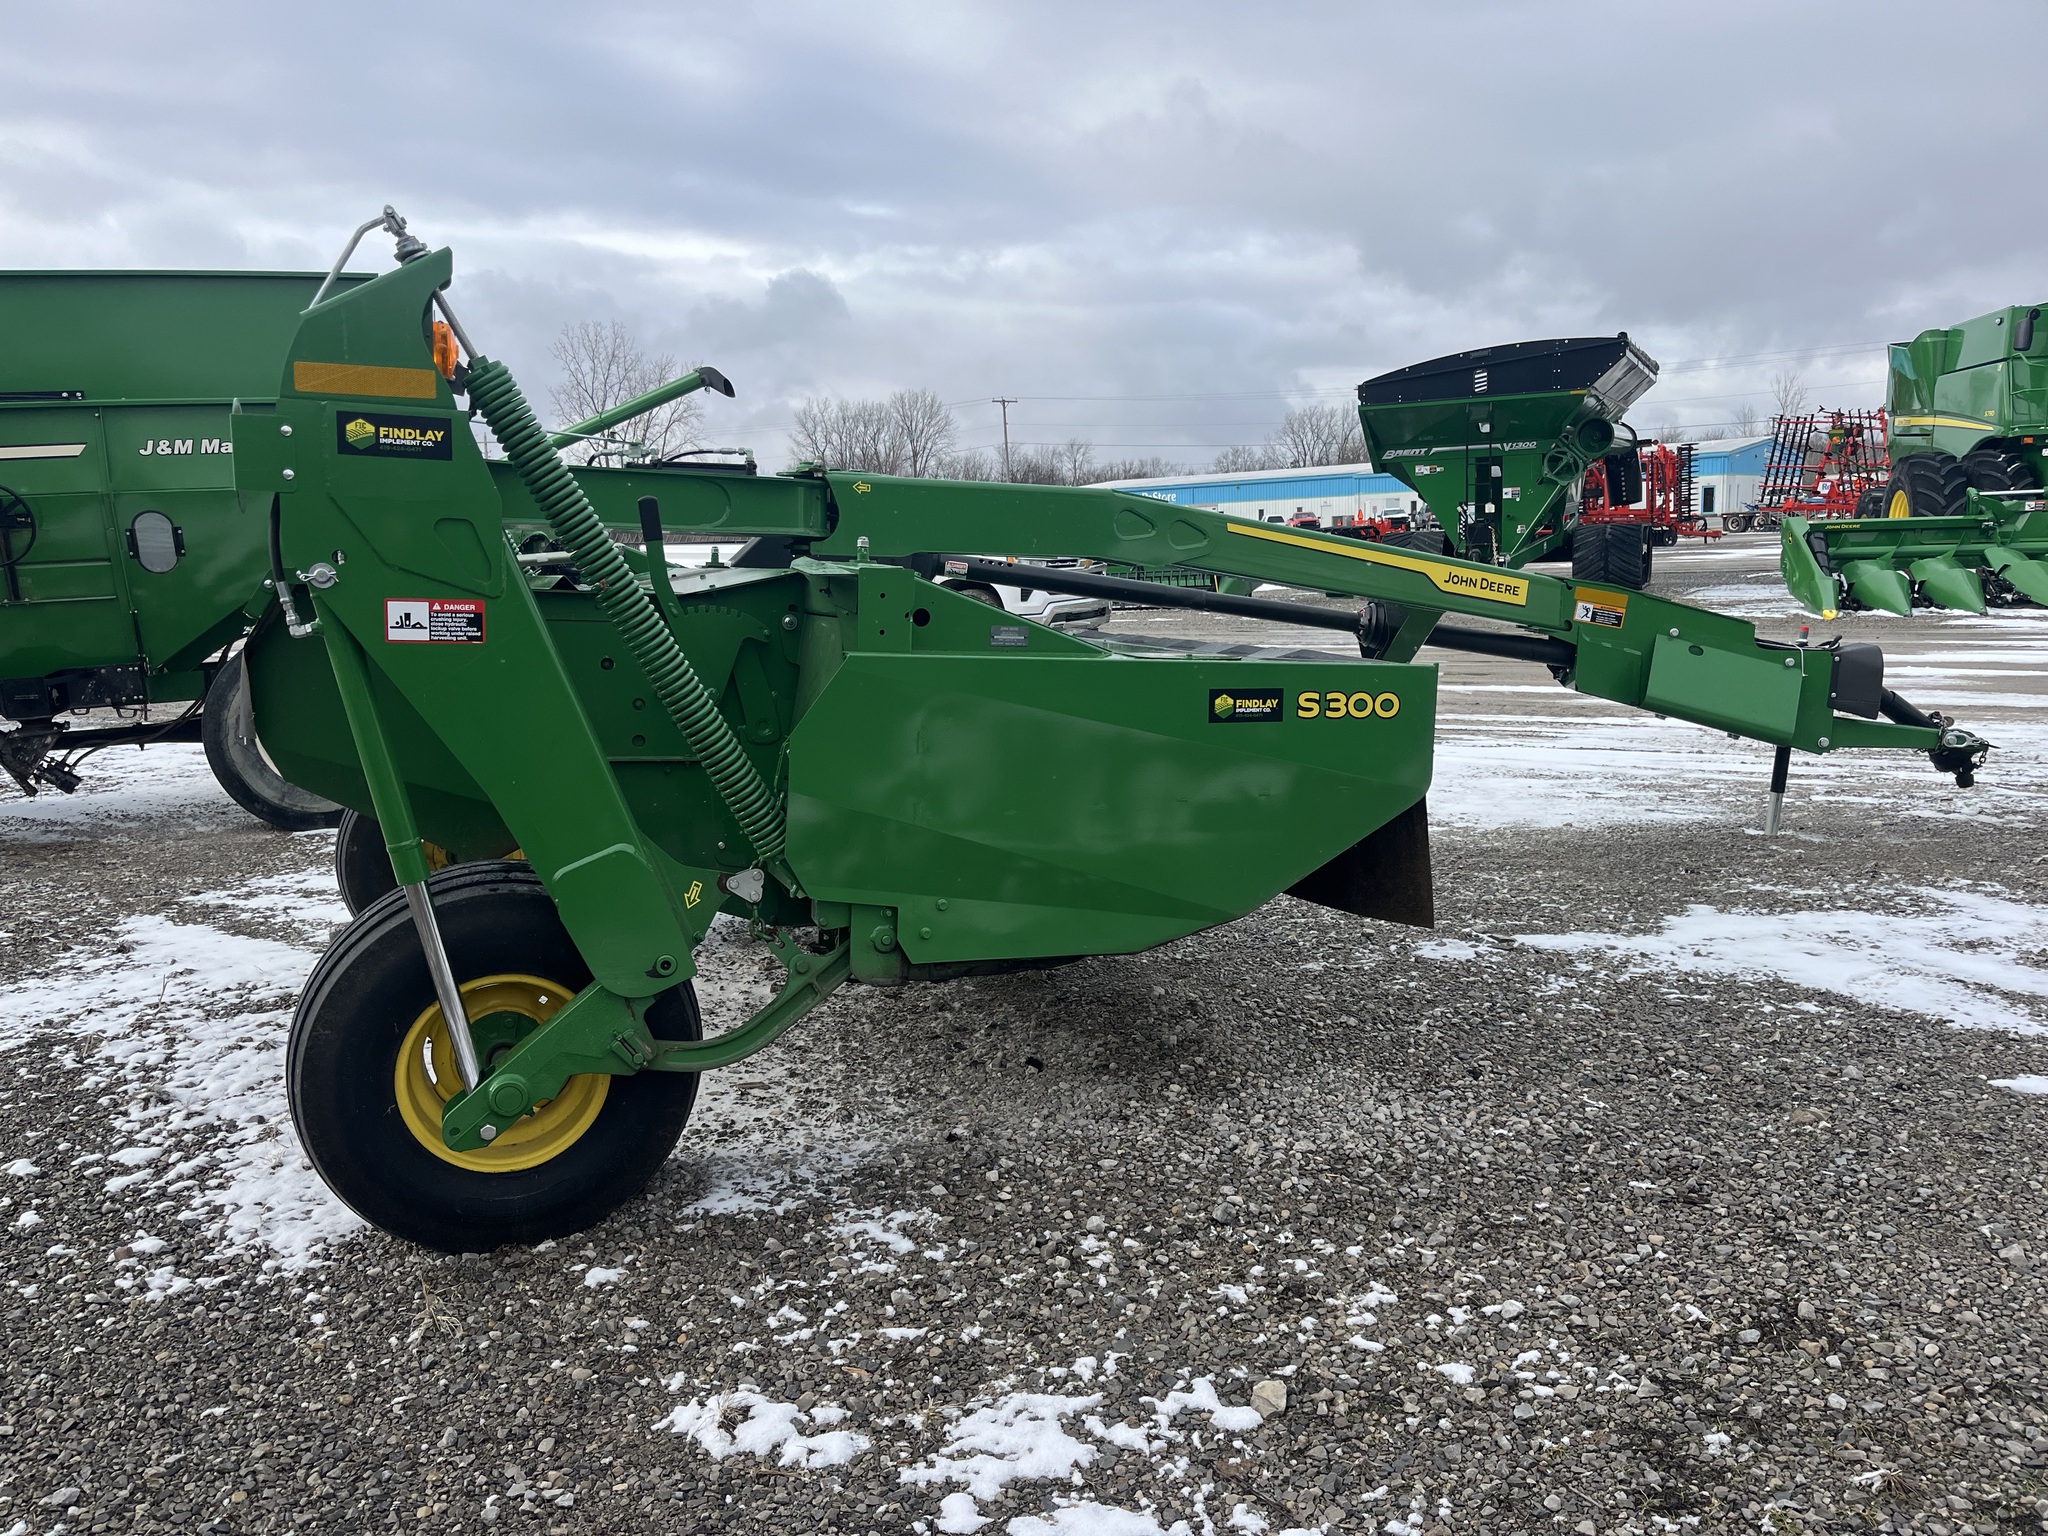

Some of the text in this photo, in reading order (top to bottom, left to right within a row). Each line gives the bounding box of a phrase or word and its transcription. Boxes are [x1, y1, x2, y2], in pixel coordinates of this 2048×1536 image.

[379, 427, 444, 441] FINDLAY
[139, 439, 194, 456] J&M
[1502, 441, 1537, 451] V1300
[1382, 448, 1428, 460] BRENT
[1444, 571, 1521, 596] JOHN DEERE
[1236, 699, 1278, 708] FINDLAY
[1297, 691, 1400, 719] S300
